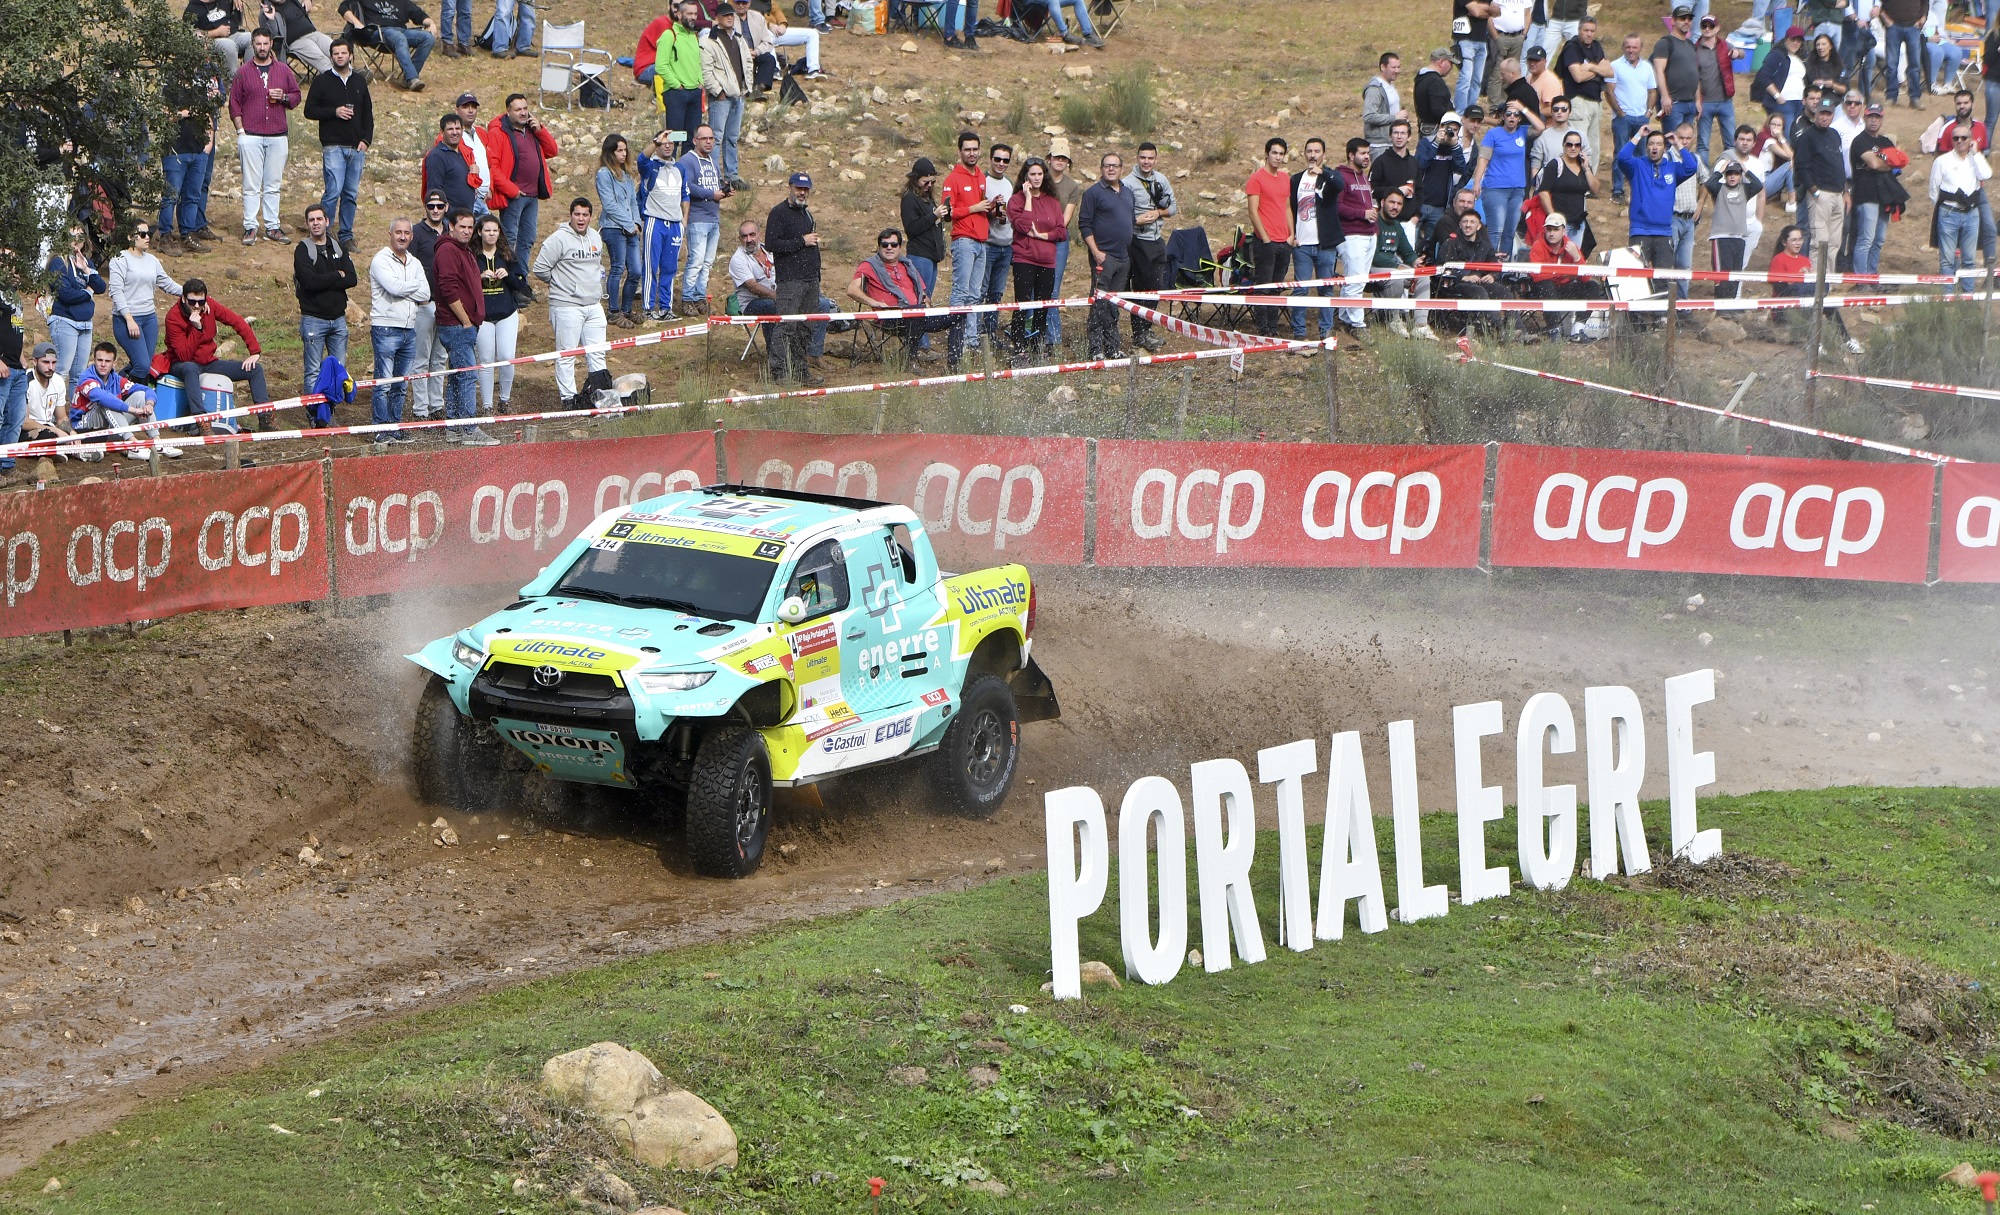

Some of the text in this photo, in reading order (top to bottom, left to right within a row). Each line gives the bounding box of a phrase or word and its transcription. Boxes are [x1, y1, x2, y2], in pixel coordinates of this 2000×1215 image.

[344, 490, 445, 562] acp
[469, 478, 569, 550] acp
[913, 462, 1046, 550] acp
[1130, 468, 1442, 555] acp acp
[1532, 472, 1885, 567] acp acp
[595, 538, 619, 550] 214
[612, 524, 632, 535] L2
[627, 533, 696, 547] ultimate
[66, 515, 173, 592] acp
[197, 501, 310, 576] acp
[760, 545, 780, 556] L2
[957, 577, 1027, 615] ultimate
[529, 619, 614, 632] enerre
[513, 641, 606, 661] ultimate
[858, 629, 940, 671] enerre
[926, 691, 942, 702] acp
[829, 706, 850, 719] Hertz
[509, 729, 617, 754] TOYOTA
[834, 716, 915, 750] Castrol EDGE
[1045, 669, 1722, 1000] PORTALEGRE
